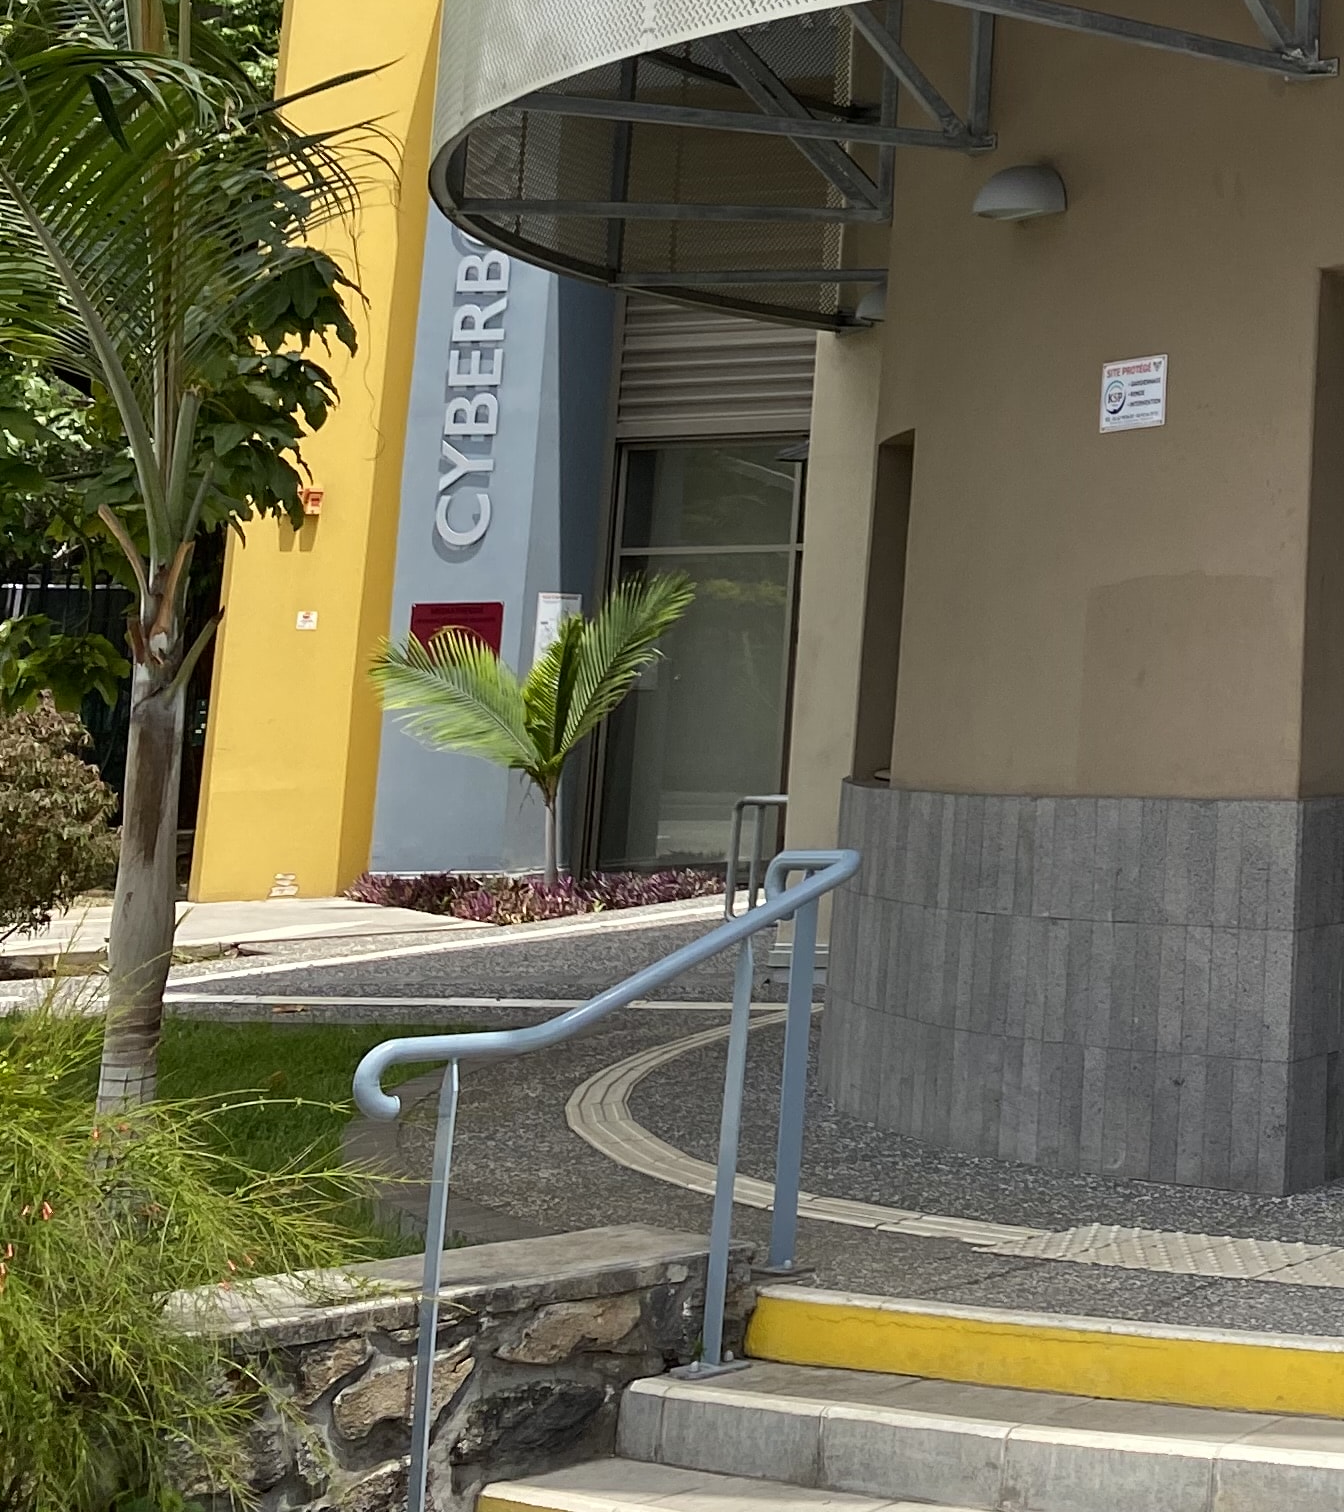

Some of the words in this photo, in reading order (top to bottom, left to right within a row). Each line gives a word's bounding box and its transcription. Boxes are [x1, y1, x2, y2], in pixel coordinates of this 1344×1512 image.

[1106, 368, 1121, 378] SITE
[436, 230, 511, 547] CYBERB
[1108, 392, 1123, 404] KSP
